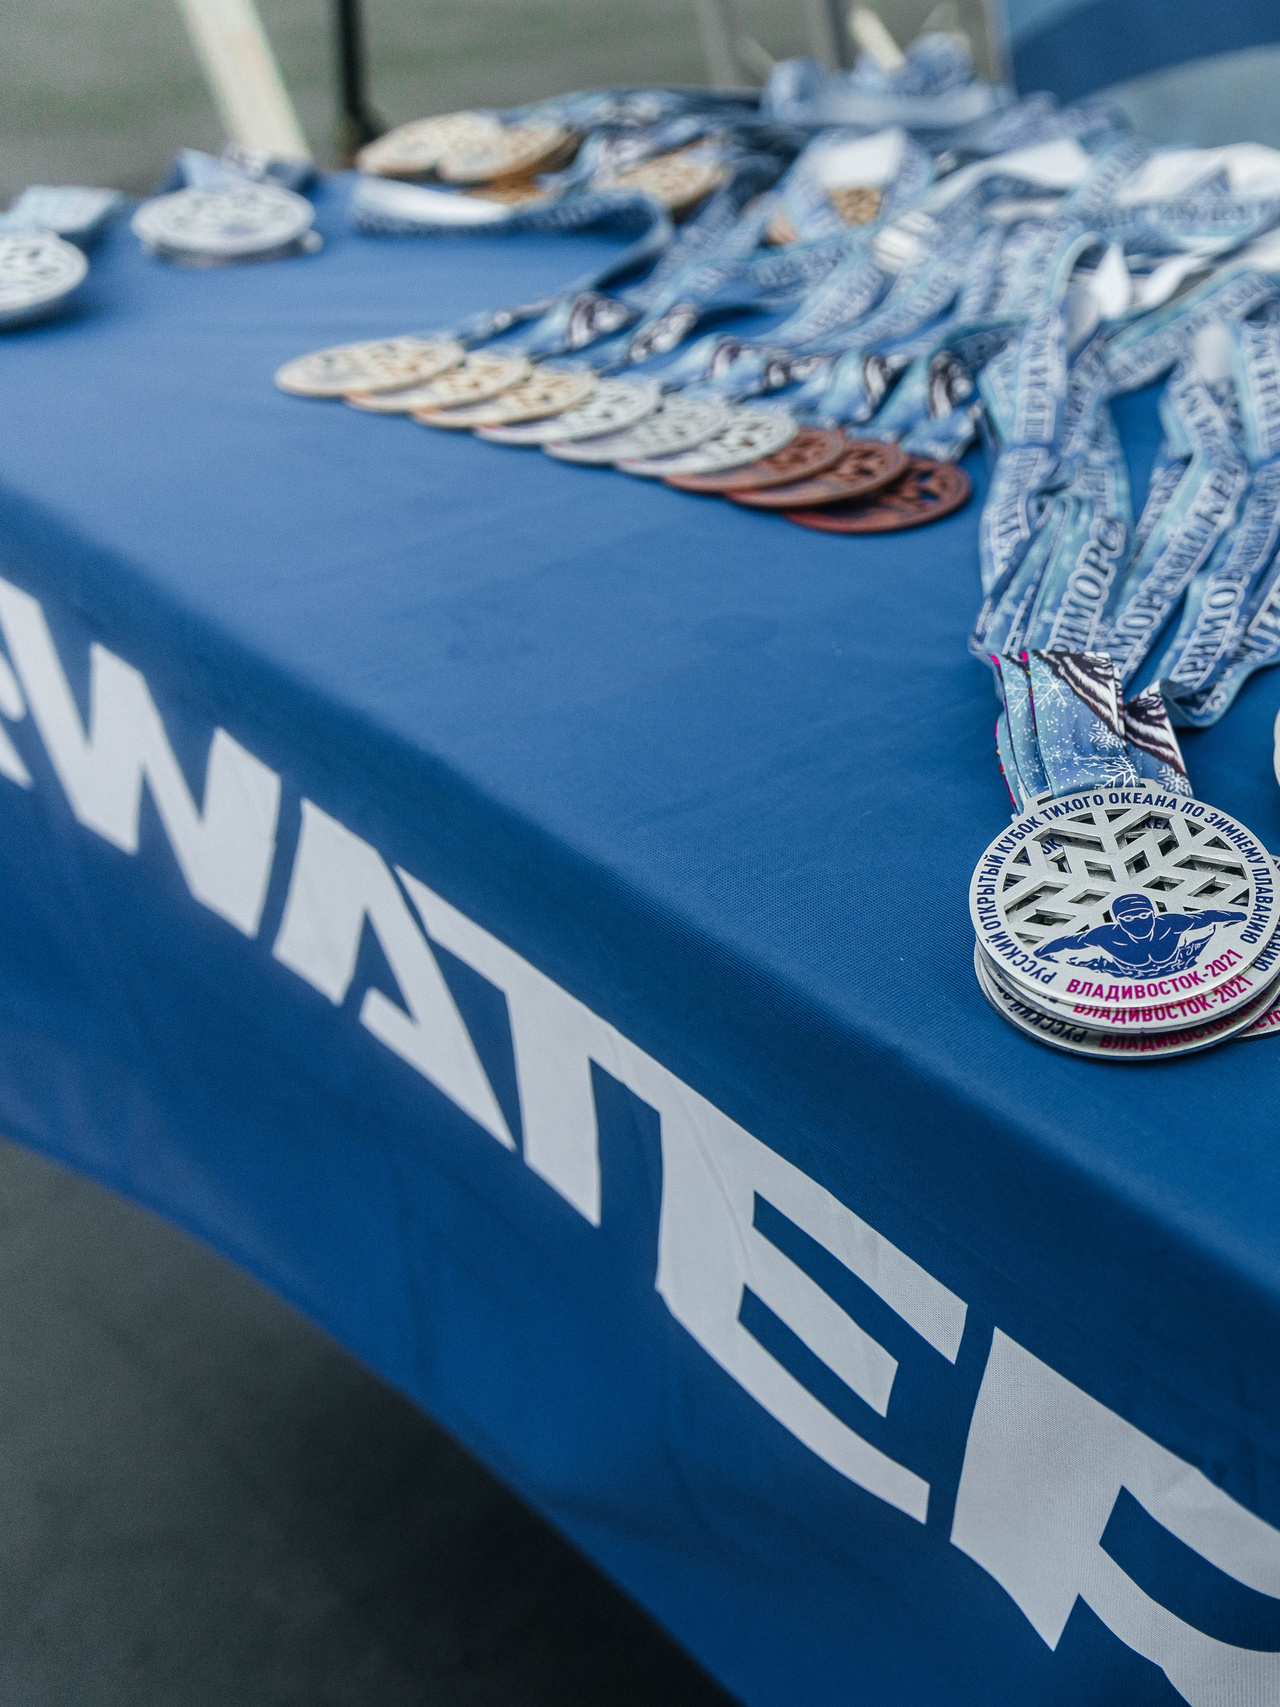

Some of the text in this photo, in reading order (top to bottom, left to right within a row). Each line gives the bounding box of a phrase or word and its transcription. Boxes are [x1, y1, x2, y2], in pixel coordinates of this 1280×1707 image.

[1039, 791, 1105, 823] ТИХОГО
[1108, 791, 1179, 810] ОКЕАНА
[1180, 800, 1206, 818] ПО
[997, 814, 1042, 853] КУБОК
[1204, 811, 1265, 870] ЗИМНЕМУ
[976, 852, 1008, 930] ОТКРЫТЫЙ
[1240, 867, 1274, 944] ПЛАВАНИЮ
[986, 936, 1057, 985] РУССКИЙ
[1065, 948, 1244, 1002] ВЛАДИВОСТОК-2021
